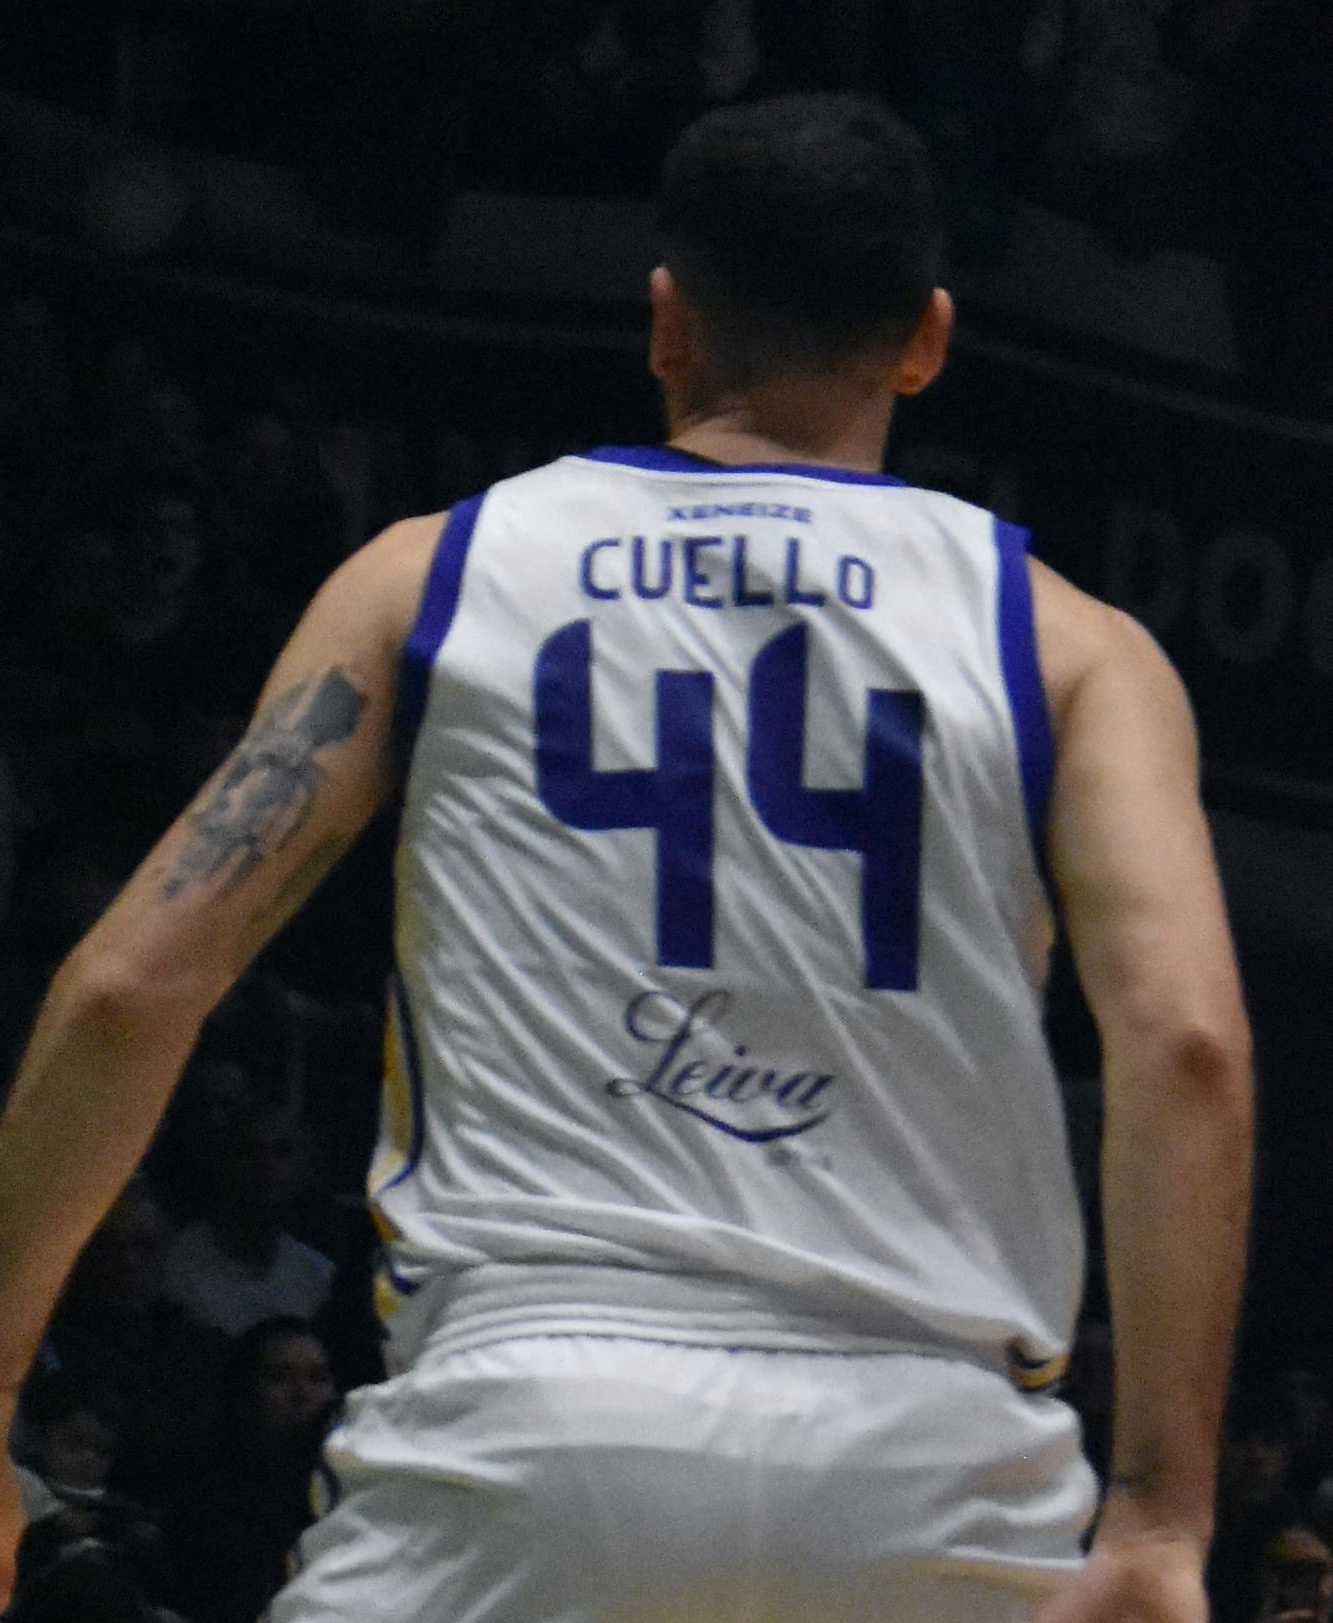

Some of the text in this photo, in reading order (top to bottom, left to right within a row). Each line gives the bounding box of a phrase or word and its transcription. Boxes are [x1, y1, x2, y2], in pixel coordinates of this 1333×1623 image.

[581, 535, 875, 610] CUELLO
[534, 617, 925, 992] 44
[605, 990, 836, 1142] Leiva
